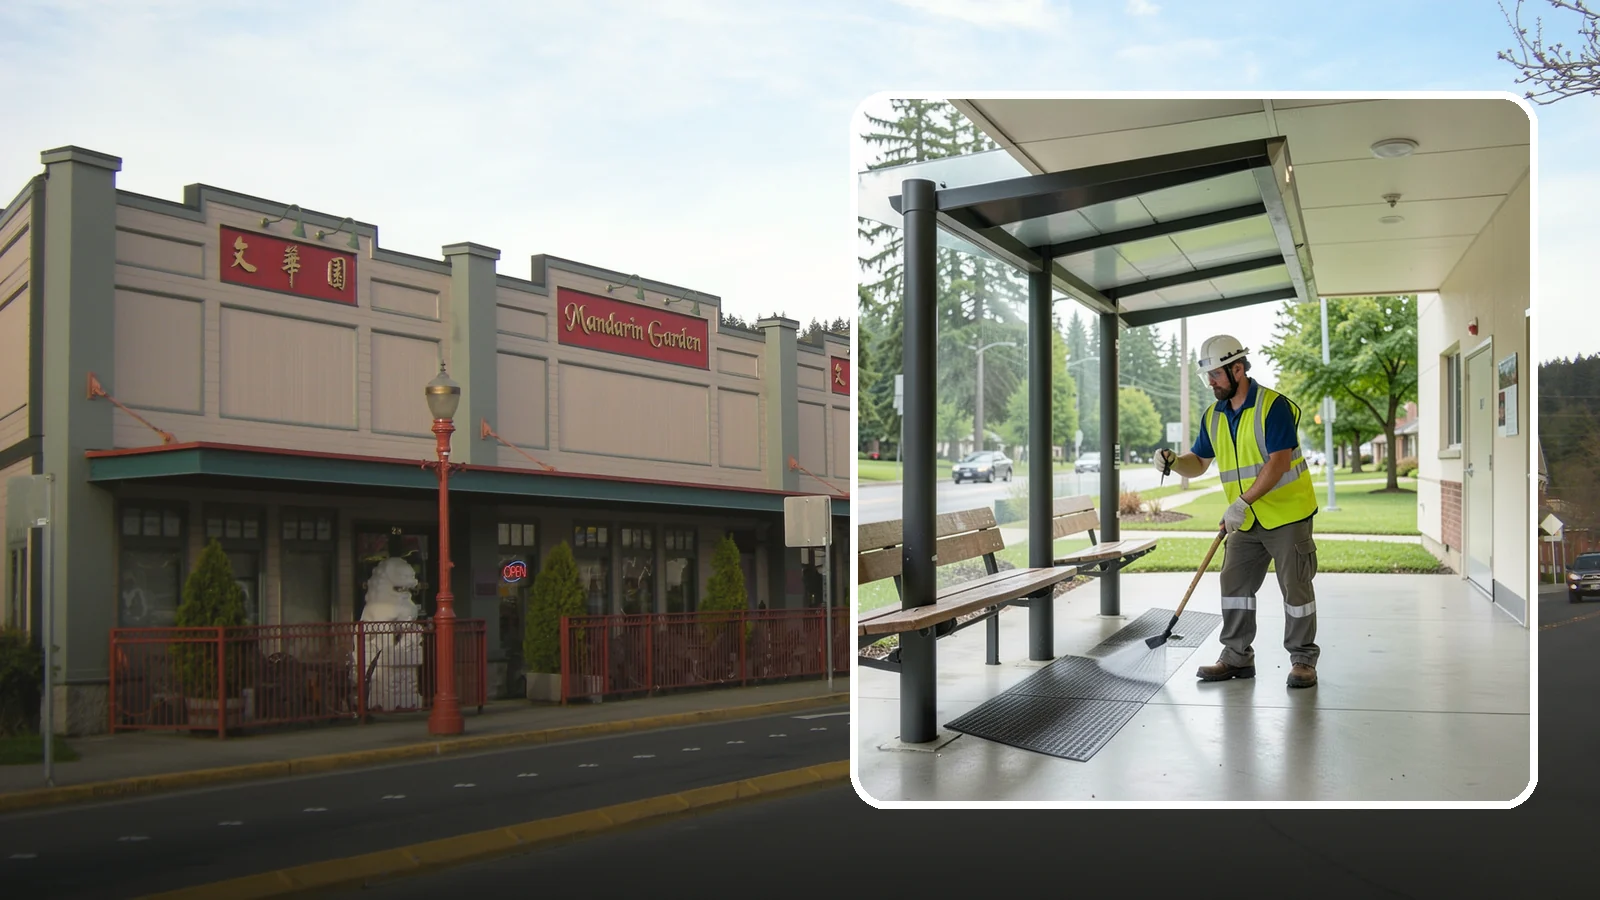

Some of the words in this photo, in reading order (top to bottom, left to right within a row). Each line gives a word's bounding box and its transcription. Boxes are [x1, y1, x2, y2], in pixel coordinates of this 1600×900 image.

[231, 236, 346, 291] 文華園
[565, 302, 644, 341] Mandarin
[648, 320, 701, 352] Garden
[503, 565, 527, 578] OPEN
